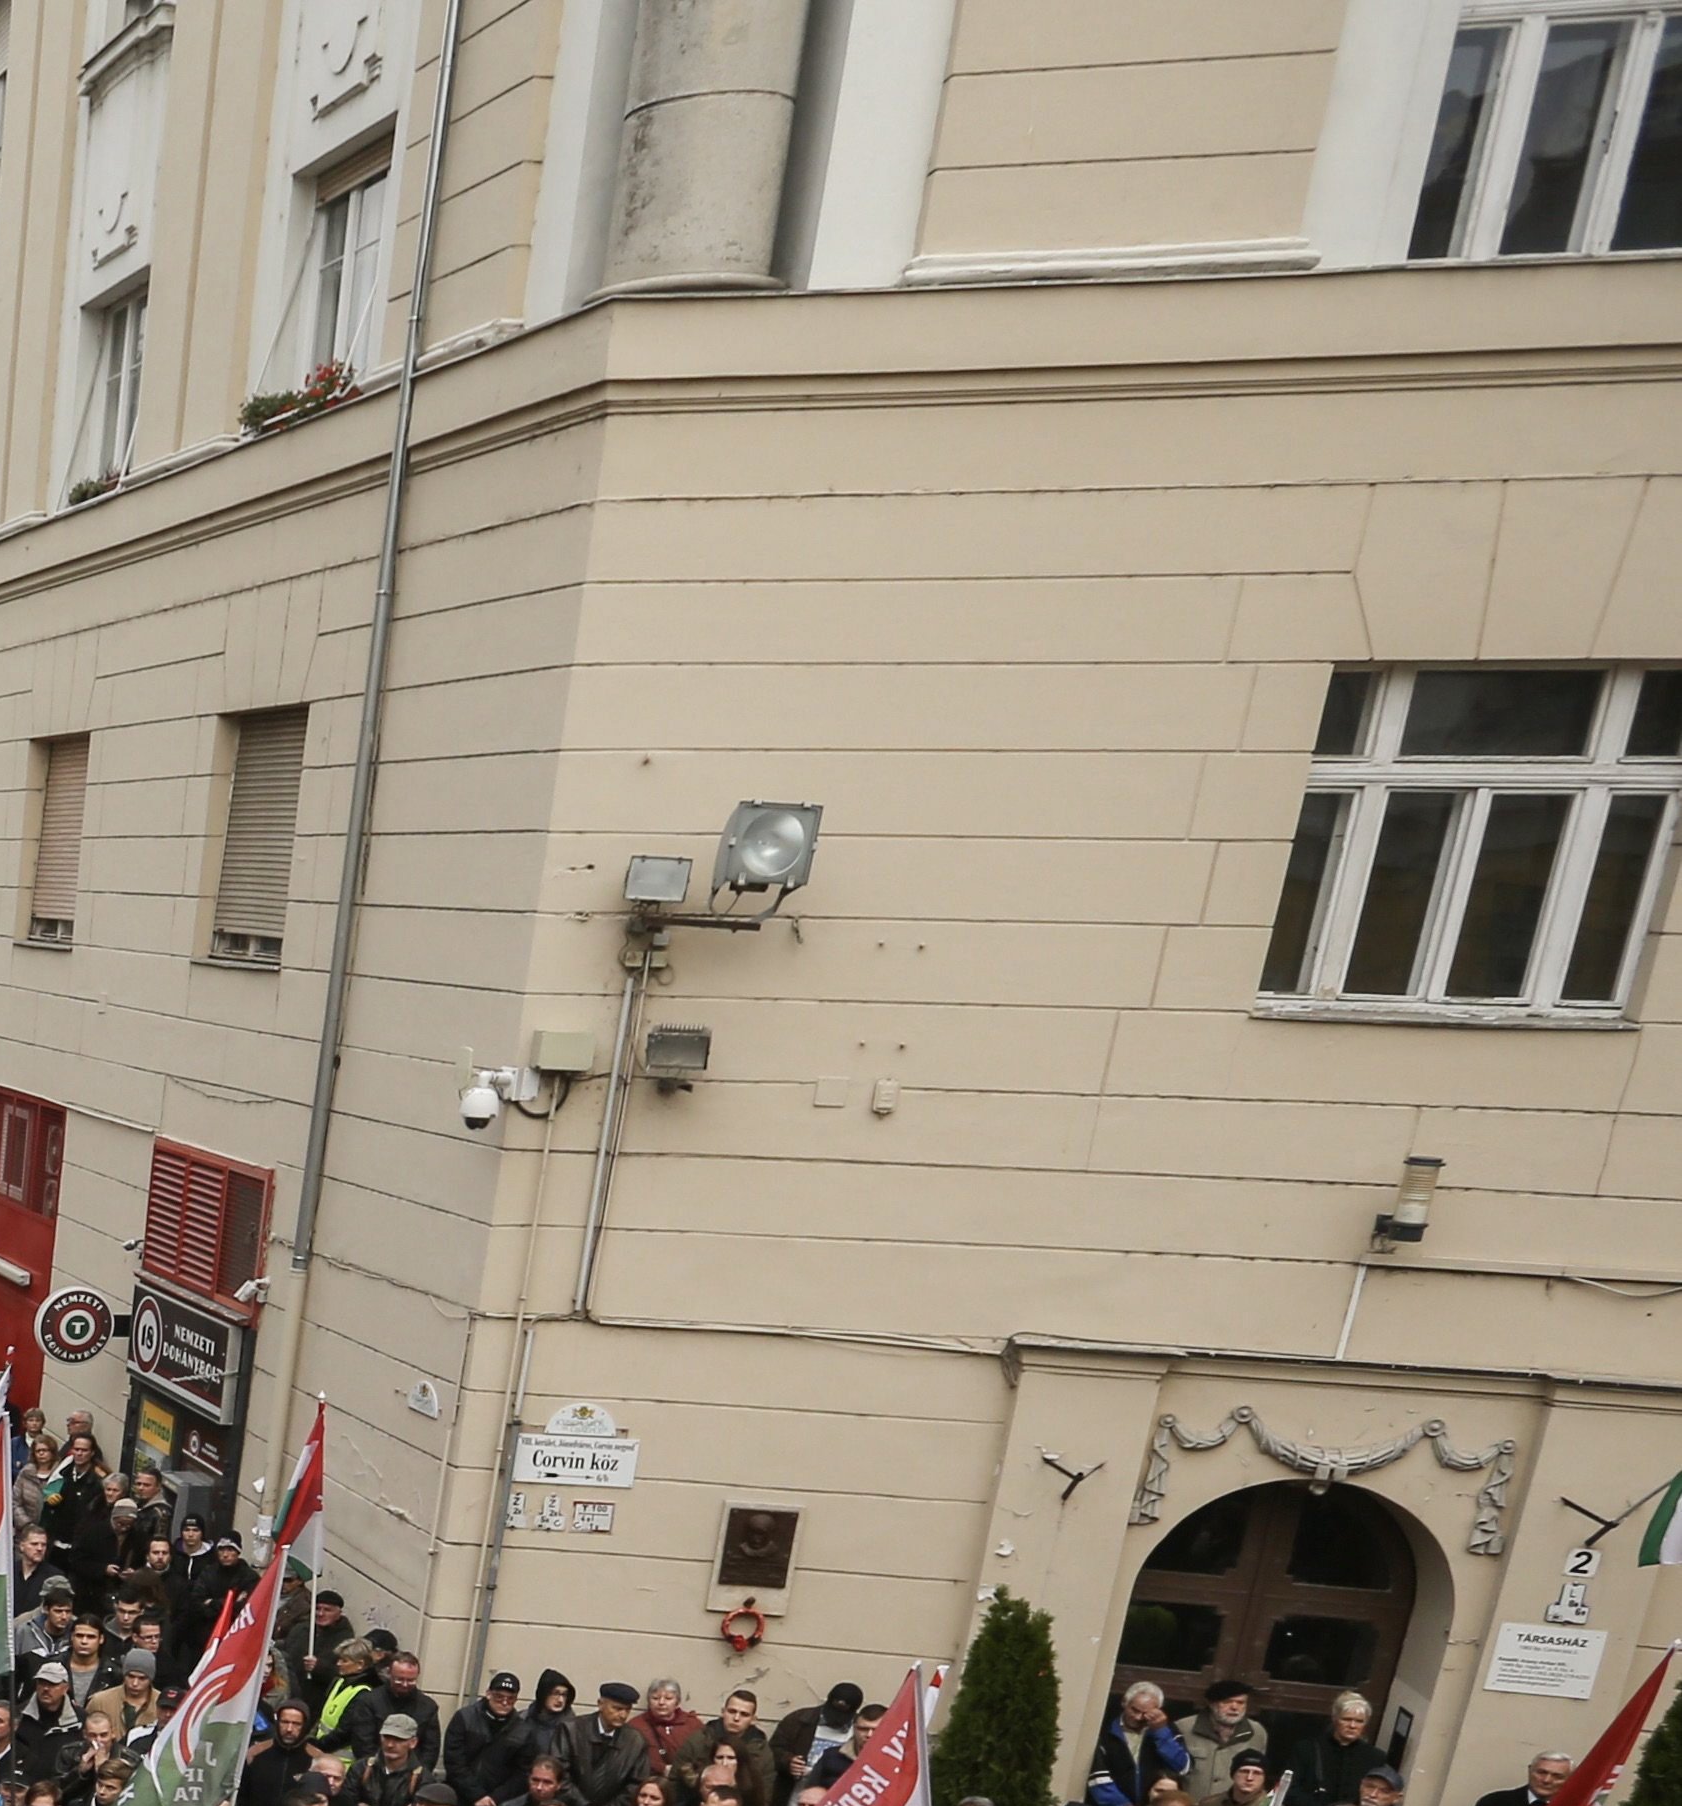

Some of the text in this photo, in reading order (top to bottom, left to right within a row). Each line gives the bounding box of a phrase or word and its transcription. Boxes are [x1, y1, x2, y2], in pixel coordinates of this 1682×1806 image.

[54, 1294, 104, 1312] NEMZETI
[71, 1321, 85, 1335] T
[45, 1333, 108, 1361] DOHÁNYBOLT
[174, 1324, 215, 1356] NEMZETI
[533, 1450, 619, 1472] Corvin köz
[1569, 1551, 1592, 1574] 2
[1517, 1633, 1589, 1648] TÁRSASHÁZ
